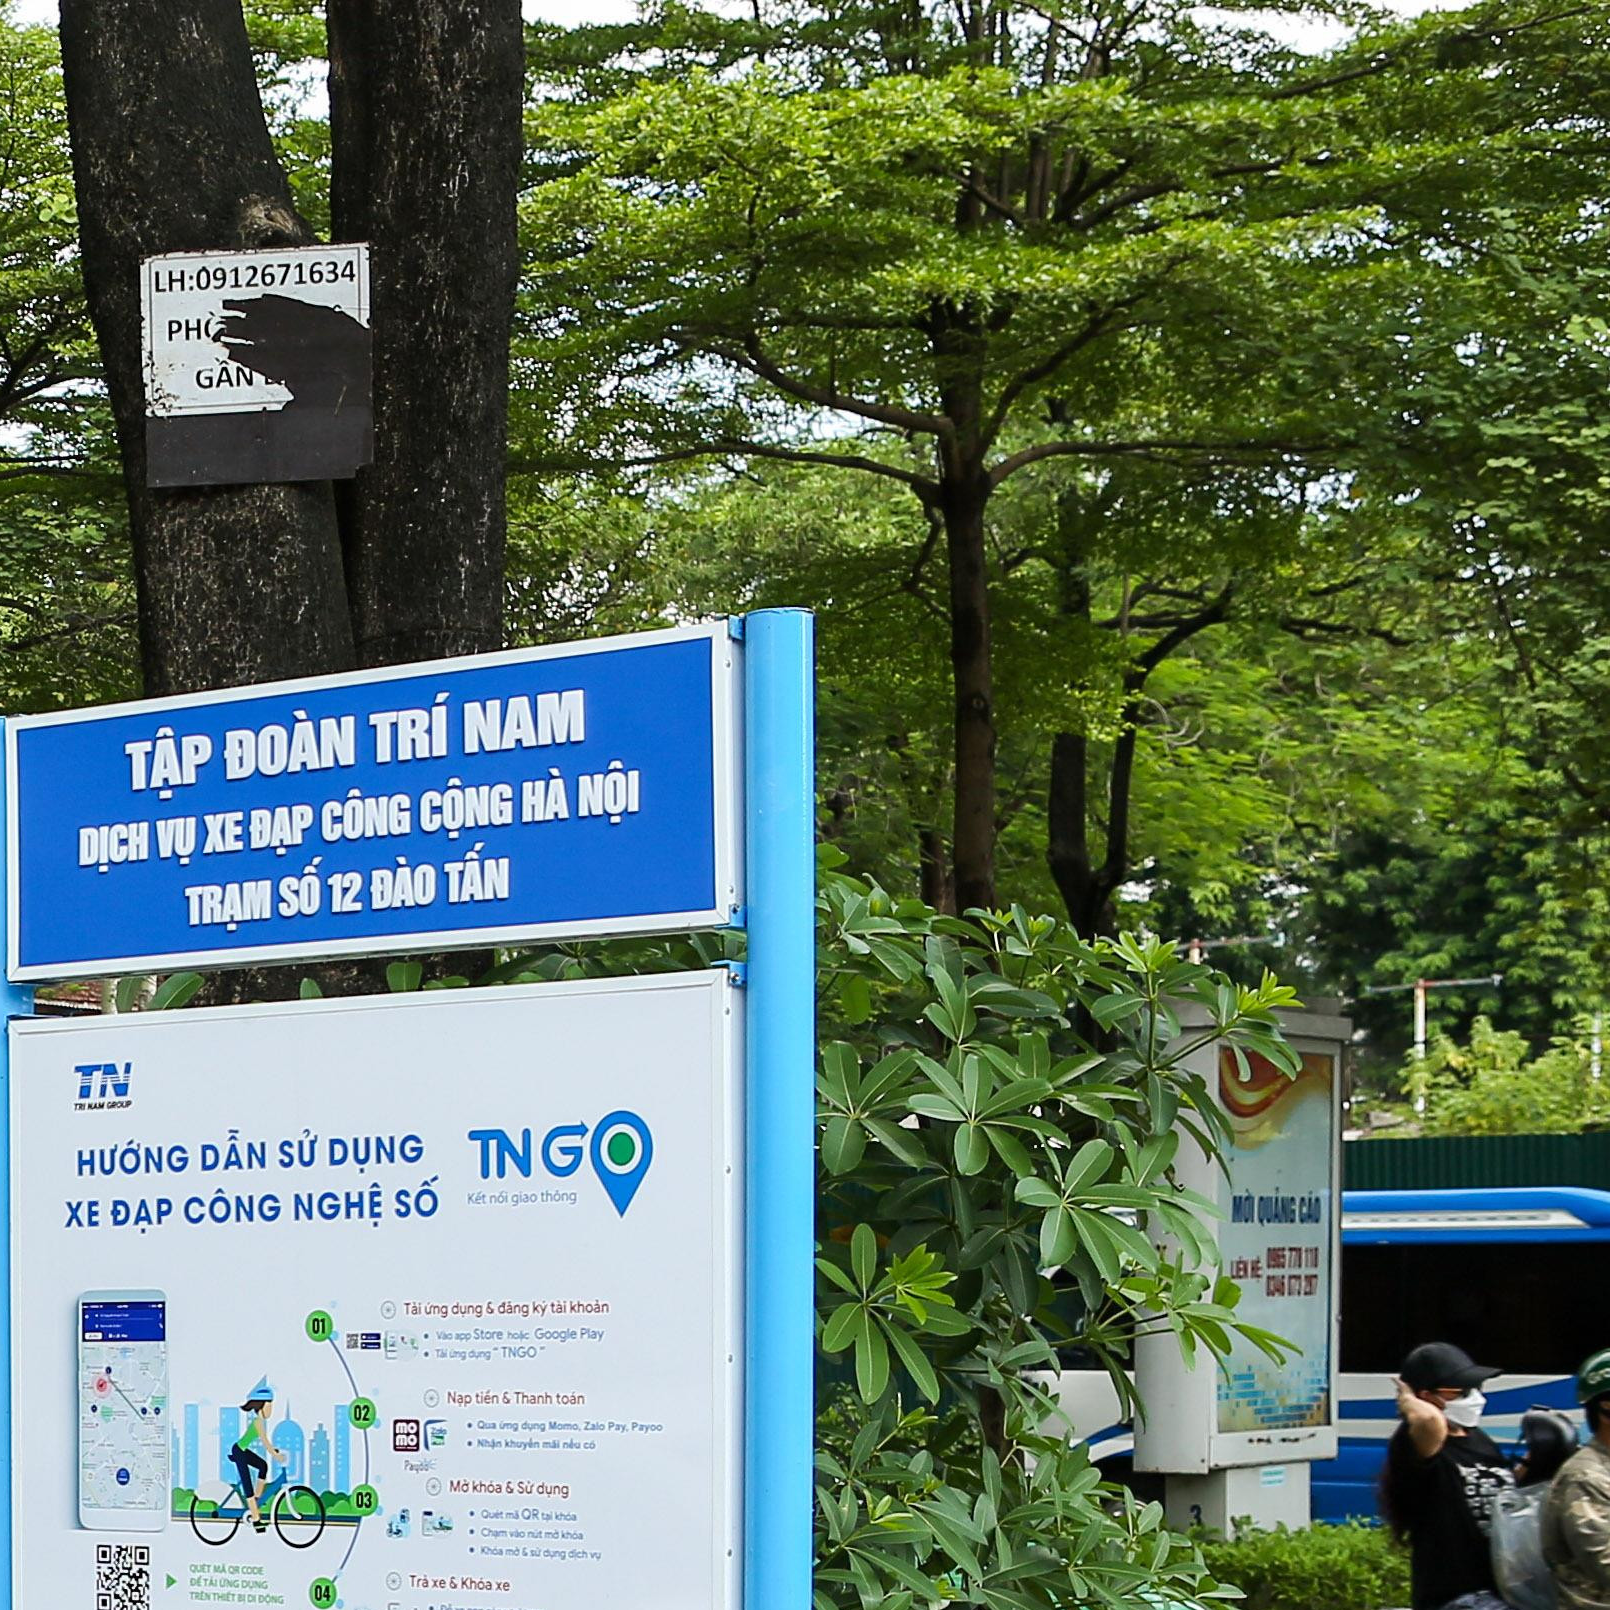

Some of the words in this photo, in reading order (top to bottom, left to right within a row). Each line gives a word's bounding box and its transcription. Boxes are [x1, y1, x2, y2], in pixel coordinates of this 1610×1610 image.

[155, 260, 356, 292] LH:0912671634
[196, 358, 253, 389] GẦN
[125, 727, 212, 799] TẬP
[224, 710, 355, 780] ĐOÀN
[369, 693, 449, 763] TRÍ
[464, 689, 585, 753] NAM
[79, 822, 148, 873] DỊCH
[157, 817, 196, 863] VỤ
[203, 812, 243, 854] XE
[250, 805, 313, 854] ĐẠP
[322, 790, 411, 842] CÔNG
[420, 778, 512, 838] CỘNG
[522, 768, 569, 823] HÀ
[578, 761, 639, 823] NỘI
[186, 881, 271, 930] TRẠM
[279, 857, 322, 916] SỐ
[328, 874, 361, 913] 12
[371, 857, 435, 909] ĐÀO
[444, 843, 509, 902] TẤN
[75, 1063, 132, 1099] TN
[75, 1103, 86, 1111] TRI
[88, 1102, 104, 1110] NAM
[107, 1100, 132, 1109] GROUP
[78, 1140, 189, 1176] HƯỚNG
[201, 1130, 266, 1171] DẪN
[279, 1130, 317, 1168] SỬ
[329, 1135, 423, 1173] DỤNG
[65, 1201, 99, 1227] XE
[111, 1199, 172, 1233] ĐẠP
[184, 1189, 280, 1224] CÔNG
[294, 1183, 382, 1227] NGHỆ
[395, 1175, 439, 1218] SỐ
[467, 1192, 486, 1204] Kết
[489, 1191, 508, 1203] nối
[511, 1194, 537, 1206] giao
[541, 1191, 577, 1204] thông
[1232, 1189, 1254, 1222] MỜI
[1258, 1186, 1296, 1226] QUẢNG
[1300, 1190, 1321, 1223] CÁO
[404, 1302, 422, 1315] Tải
[425, 1304, 448, 1318] ứng
[452, 1302, 483, 1318] dụng
[486, 1302, 494, 1314] &
[498, 1302, 528, 1316] đăng
[532, 1301, 546, 1317] ký
[550, 1301, 566, 1313] tài
[570, 1300, 609, 1313] khoản
[312, 1318, 325, 1334] 01
[447, 1393, 471, 1407] Nạp
[476, 1389, 498, 1404] tiền
[502, 1392, 510, 1404] &
[515, 1392, 552, 1404] Thanh
[556, 1392, 585, 1405] toán
[354, 1406, 369, 1421] 02
[450, 1480, 469, 1493] Mở
[473, 1481, 502, 1494] khóa
[506, 1482, 514, 1494] &
[518, 1481, 534, 1495] Sử
[538, 1482, 569, 1498] dụng
[356, 1492, 372, 1508] 03
[410, 1575, 429, 1588] Trả
[432, 1579, 446, 1589] xe
[450, 1578, 458, 1589] &
[461, 1578, 492, 1591] Khóa
[495, 1581, 510, 1591] xe
[315, 1586, 331, 1600] 04
